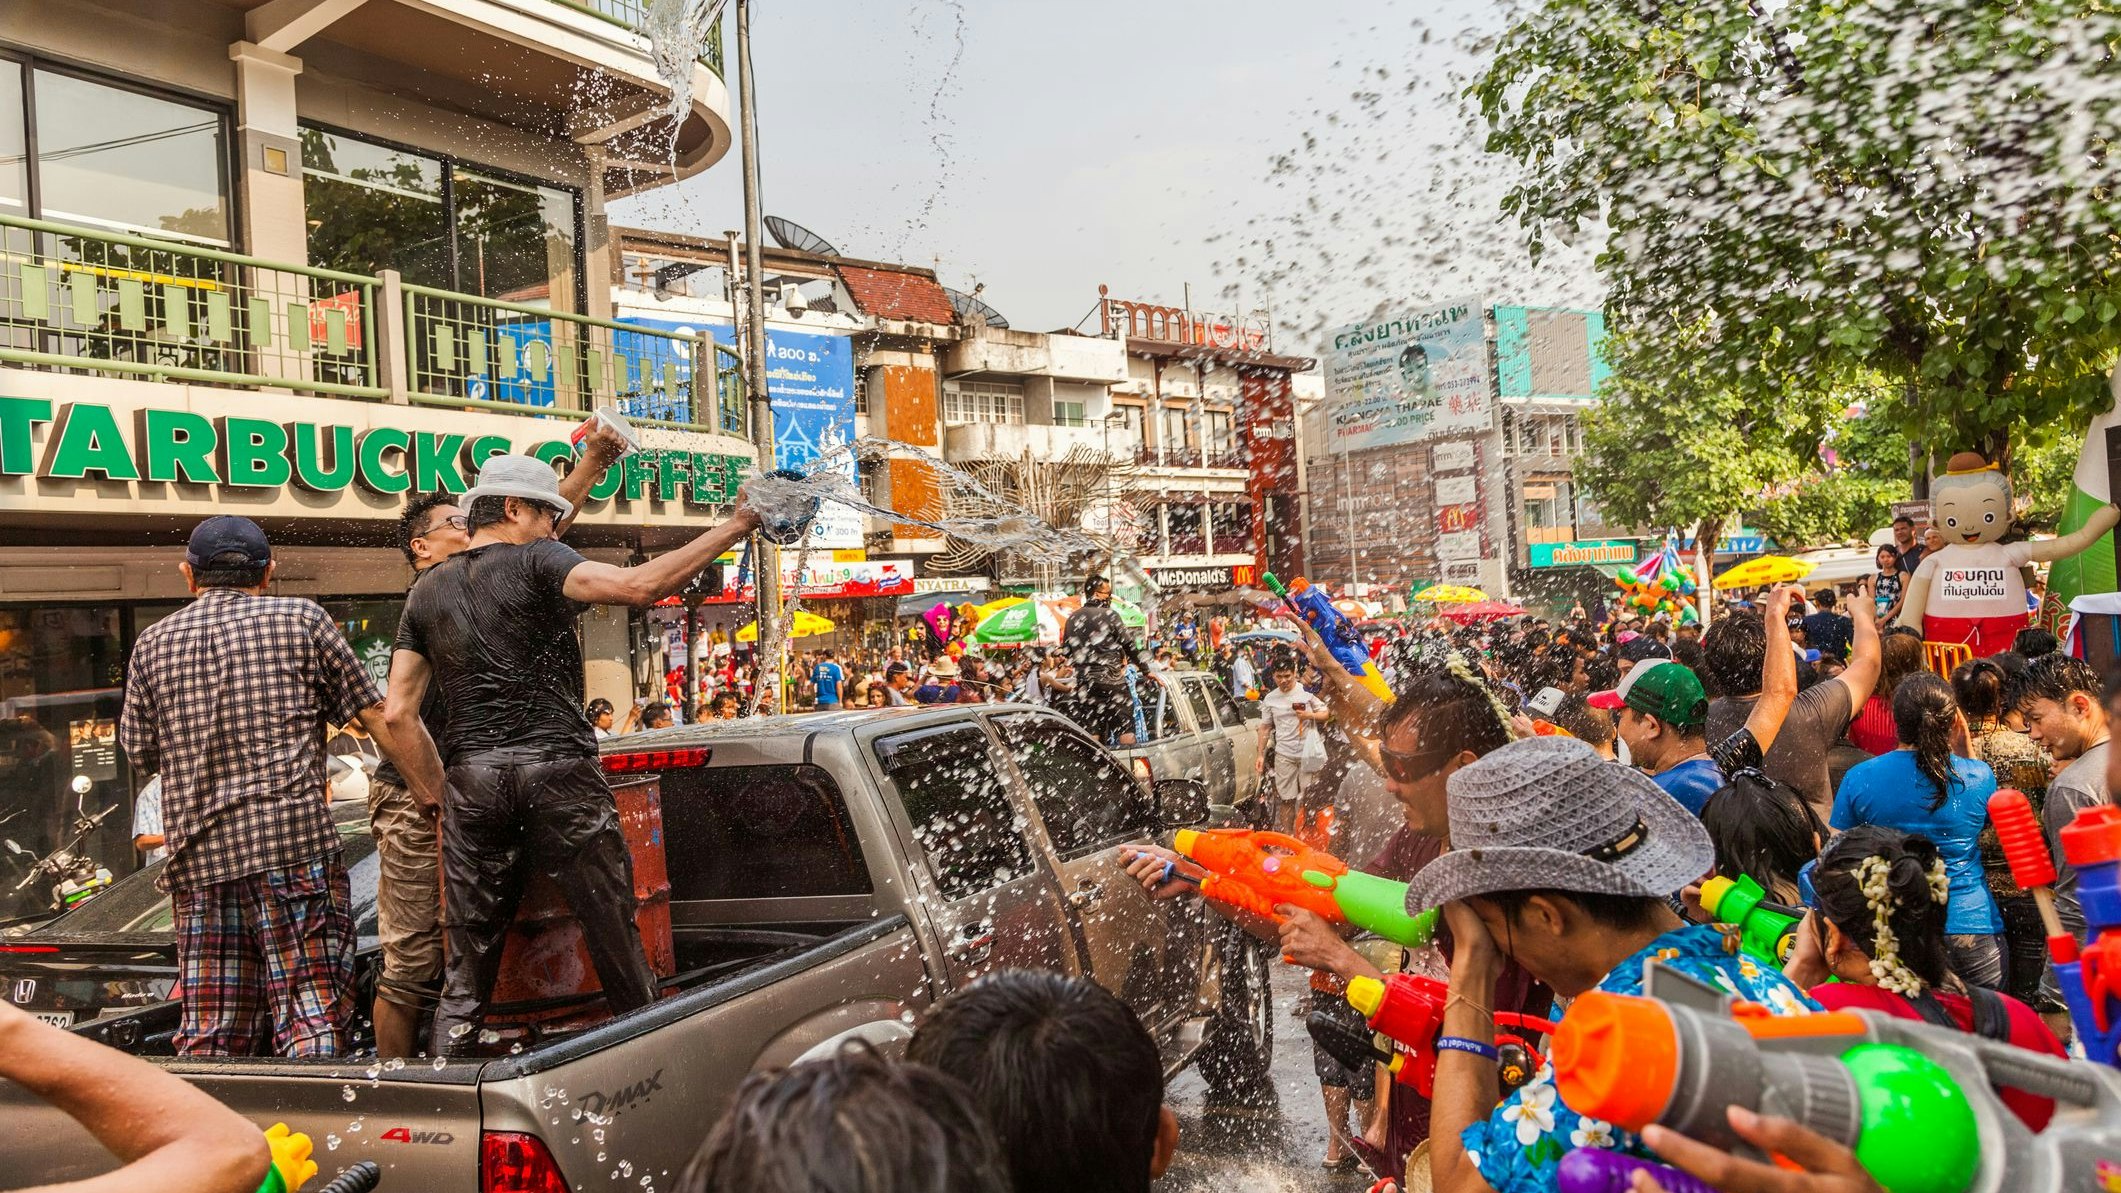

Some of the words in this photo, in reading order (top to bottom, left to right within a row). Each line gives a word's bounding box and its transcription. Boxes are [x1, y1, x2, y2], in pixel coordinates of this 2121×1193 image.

[1409, 411, 1435, 425] PRICE
[1552, 543, 1634, 564] คลังยาท่าแพ
[1157, 567, 1228, 587] McDonald's
[380, 1127, 455, 1146] 4WD
